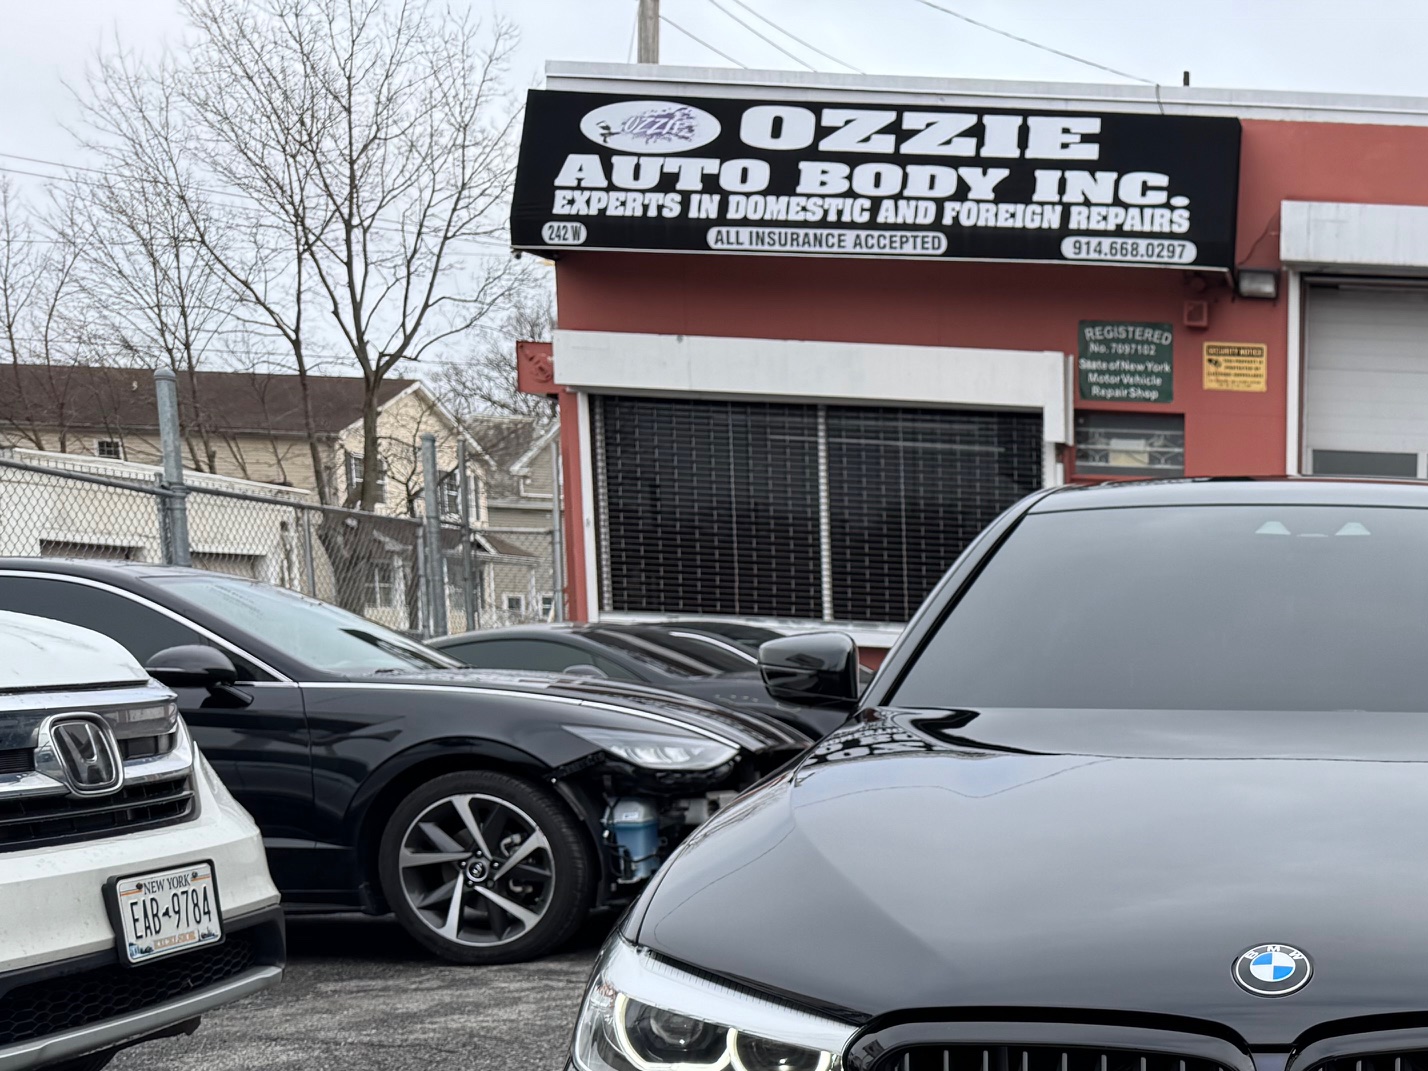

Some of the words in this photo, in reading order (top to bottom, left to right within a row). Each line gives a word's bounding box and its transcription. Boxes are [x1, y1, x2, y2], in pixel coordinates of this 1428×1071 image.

[740, 105, 1101, 160] OZZIE
[554, 154, 770, 193] AUTO
[796, 161, 1010, 199] BODY
[1032, 169, 1190, 207] INC.
[552, 190, 682, 218] EXPERTS
[688, 193, 720, 219] IN
[726, 194, 871, 223] DOMESTIC
[876, 199, 936, 225] AND
[942, 201, 1063, 229] FOREIGN
[1068, 206, 1190, 233] REPAIRS
[548, 224, 569, 242] 242
[571, 224, 582, 242] W
[714, 229, 744, 246] ALL
[749, 230, 847, 249] INSURANCE
[853, 233, 942, 251] ACCEPTED
[1073, 240, 1186, 259] 914.668.0297
[1084, 325, 1172, 346] REGISTERED
[1089, 341, 1110, 354] No.
[1078, 357, 1108, 370] State
[1108, 360, 1120, 371] of
[1120, 360, 1145, 372] New
[1145, 361, 1171, 373] York
[1087, 372, 1120, 384] Motor
[1120, 373, 1163, 387] Vehicle
[1091, 385, 1127, 399] Repair
[1128, 387, 1159, 400] Shop
[143, 878, 165, 895] NEW
[166, 873, 190, 890] YORK
[1244, 945, 1305, 960] BMW
